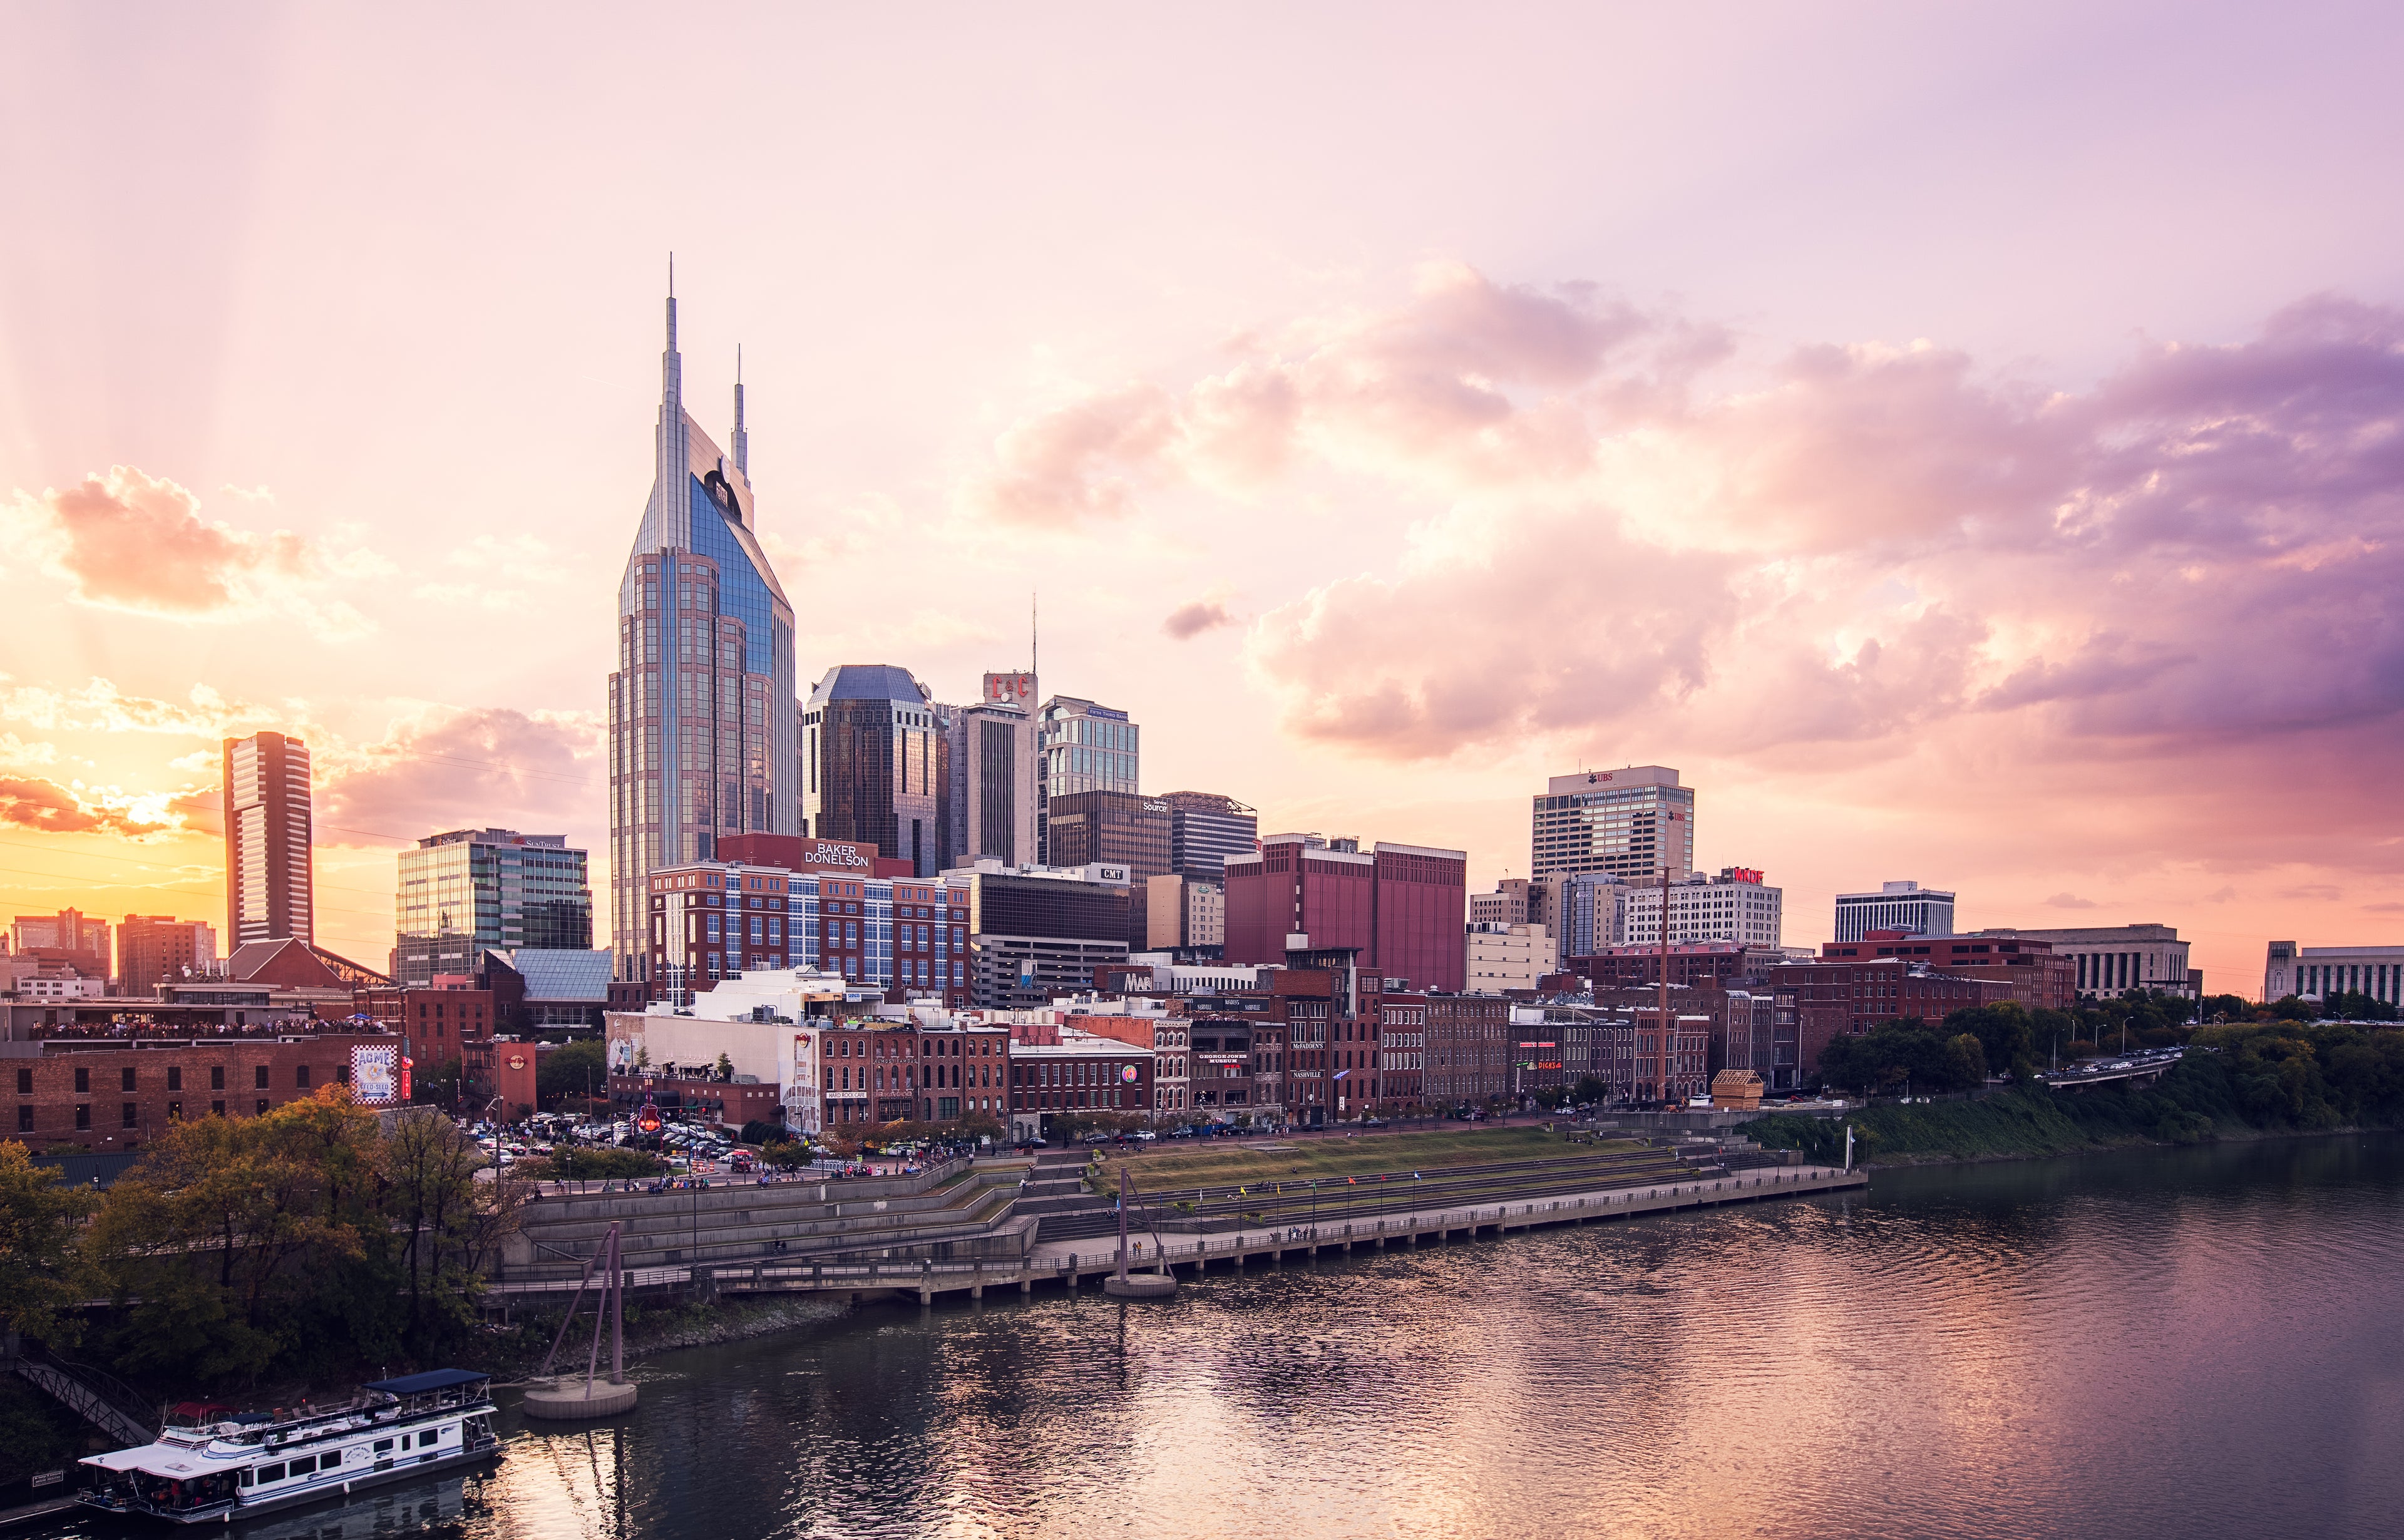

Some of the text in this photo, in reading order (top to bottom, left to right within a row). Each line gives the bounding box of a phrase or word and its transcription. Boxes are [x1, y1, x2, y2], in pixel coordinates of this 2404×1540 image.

[1005, 679, 1014, 691] &
[1598, 773, 1613, 782] UBS
[1143, 802, 1167, 813] Source
[817, 843, 856, 856] BAKER
[805, 852, 868, 867] DONELSON
[1104, 869, 1121, 879] CMT
[1734, 868, 1764, 883] WKDF
[359, 1052, 389, 1065] ACME
